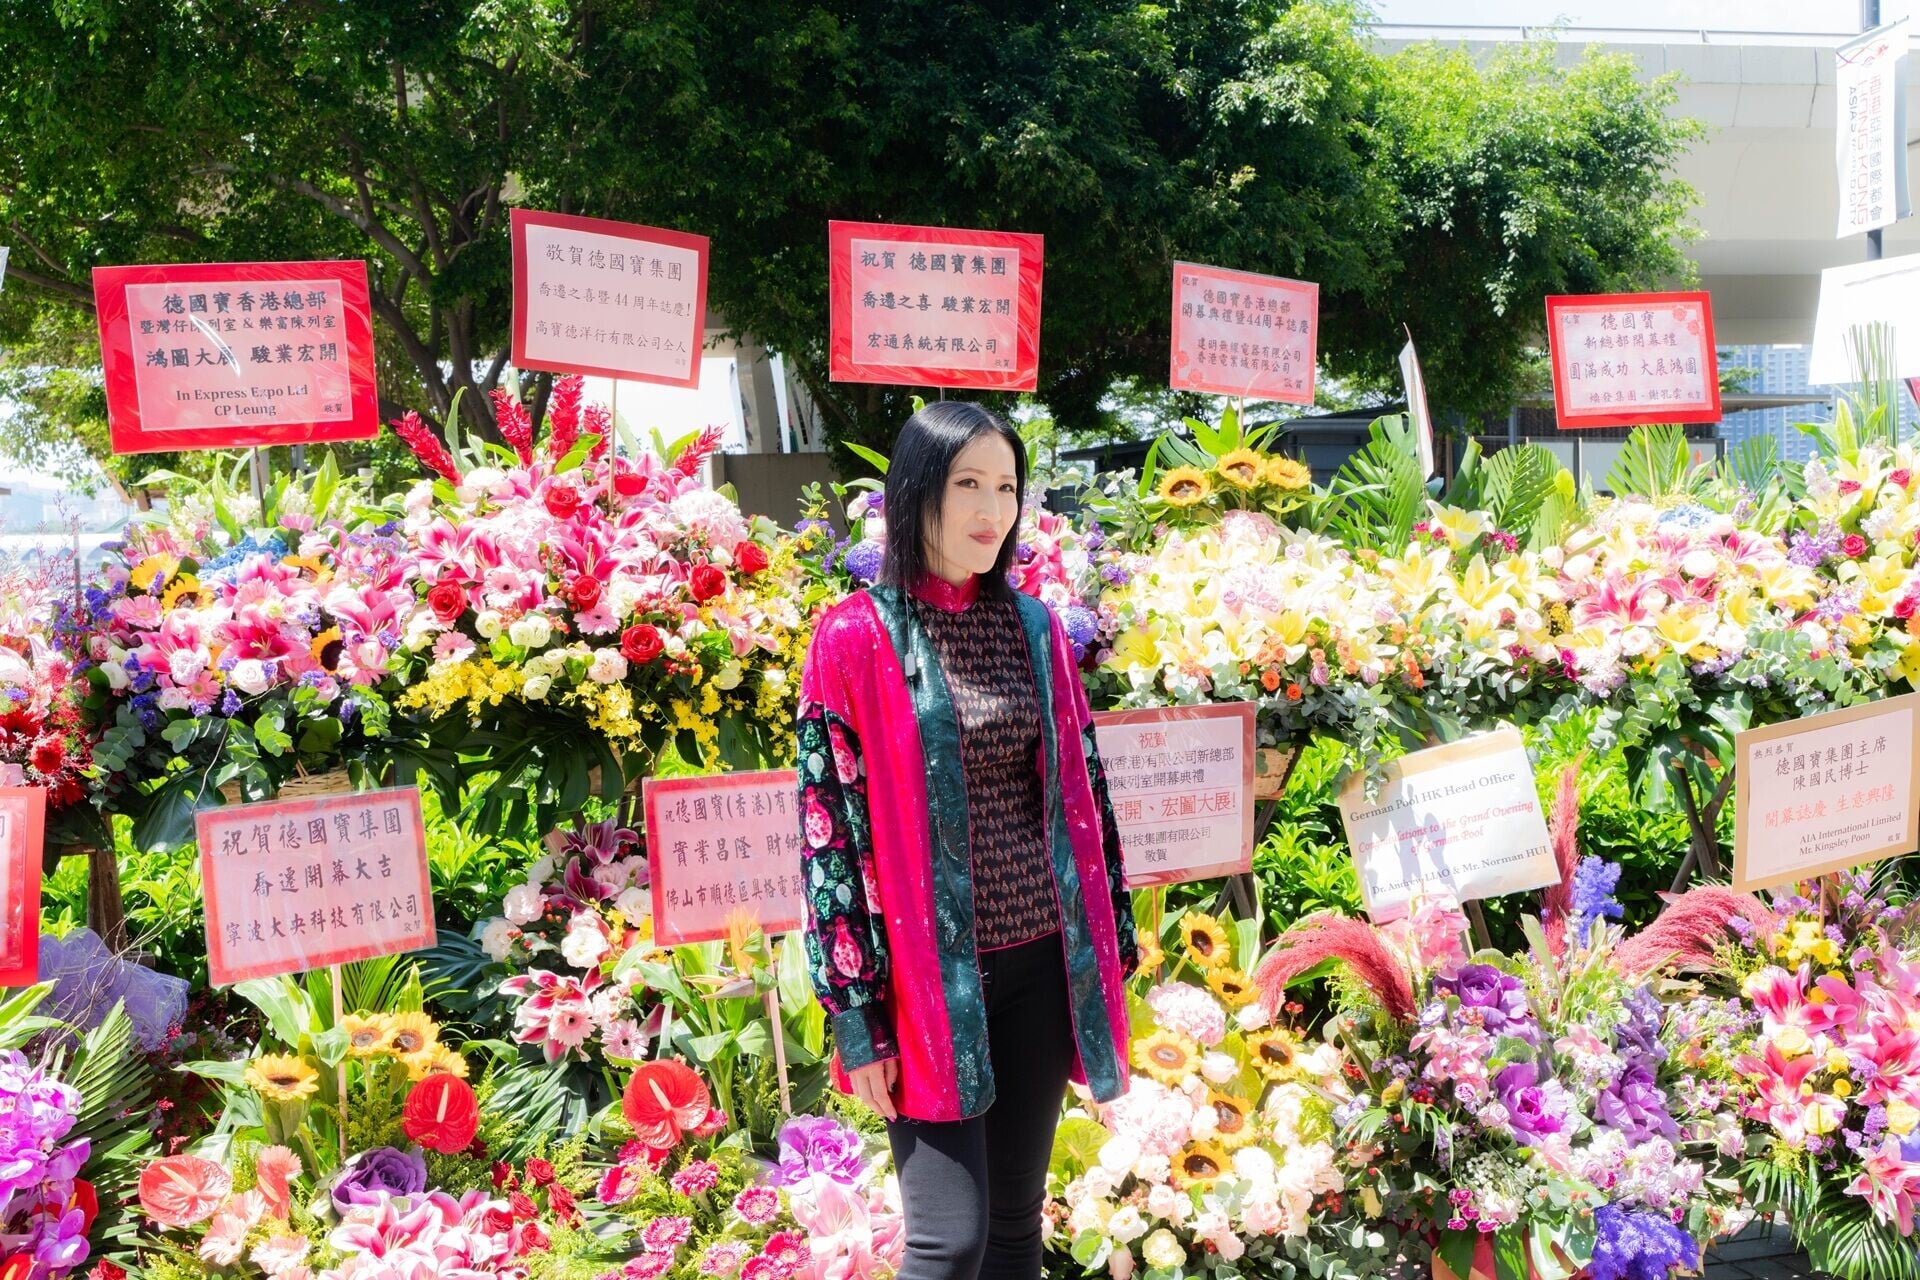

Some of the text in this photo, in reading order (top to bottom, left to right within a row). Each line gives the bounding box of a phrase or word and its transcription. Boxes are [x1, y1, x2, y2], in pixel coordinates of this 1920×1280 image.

[1857, 155, 1868, 225] KONG
[546, 244, 682, 282] 敬賀德國寶集團
[861, 251, 1007, 275] 祝賀 德國寶集團
[163, 291, 327, 314] 德國寶香港總部
[863, 291, 1010, 316] 喬遷之喜 駿業宏開
[1203, 289, 1290, 314] 德國寶香港總部
[140, 315, 336, 335] 暨灣仔陳列室 & 樂富陳列室
[1182, 302, 1309, 334] 開幕典禮暨44周年誌慶
[1601, 311, 1655, 331] 德國寶
[535, 320, 686, 353] 高寶德洋行有限公司仝人
[868, 332, 997, 354] 宏通系統有限公司
[1584, 333, 1677, 349] 新總部開幕禮
[146, 343, 337, 368] 鴻圖大展 駿業宏開
[1570, 357, 1697, 380] 圓滿成功 大展鴻圖
[177, 384, 308, 403] In Express Expo Ltd
[214, 403, 277, 417] CP Leung
[1139, 732, 1167, 749] 祝賀
[1754, 742, 1794, 760] 熱烈恭賀
[1775, 736, 1887, 777] 德國寶集團主席
[1793, 760, 1869, 791] 陳國民博士
[1350, 772, 1516, 822] German Pool HK Head Office
[1765, 784, 1896, 829] 開幕誌慶 生意興隆
[222, 807, 402, 857] 祝賀德國寶集團
[1429, 824, 1440, 834] to
[1441, 818, 1457, 831] the
[1459, 811, 1491, 827] Grand
[1800, 812, 1901, 844] AIA International Limited
[673, 836, 751, 867] 實業昌隆
[1423, 836, 1460, 853] German
[1460, 826, 1484, 841] Pool
[1800, 832, 1871, 856] Mr. Kingsley Poon
[1145, 849, 1167, 862] 敬賀
[253, 854, 392, 897] 喬遷開幕大吉
[1372, 884, 1387, 895] Dr.
[1388, 877, 1424, 892] Andrew
[1453, 866, 1461, 875] &
[1462, 862, 1481, 874] Mr.
[1481, 852, 1525, 868] Norman
[1526, 845, 1548, 859] HUI
[226, 894, 418, 947] 寧波大央科技有限公司
